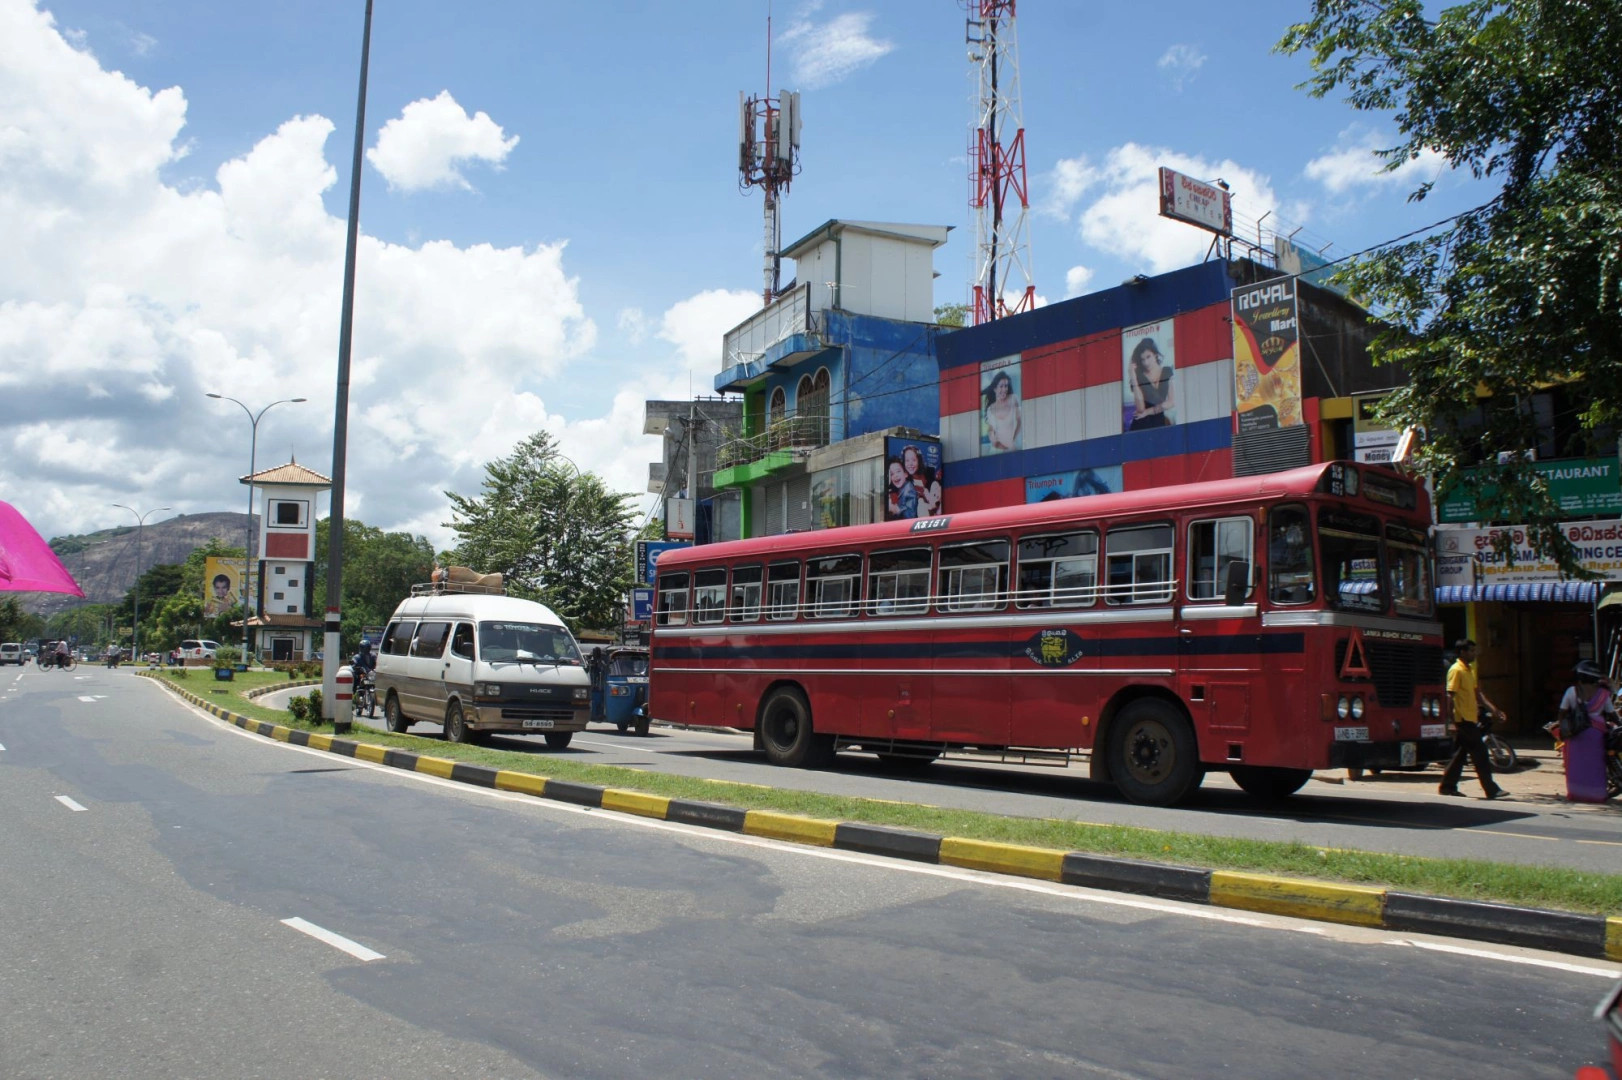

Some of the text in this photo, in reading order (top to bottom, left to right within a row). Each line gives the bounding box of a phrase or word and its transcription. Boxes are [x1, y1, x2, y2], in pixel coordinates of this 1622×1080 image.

[1238, 283, 1294, 311] ROYAL
[1271, 316, 1297, 332] Mart
[1126, 325, 1155, 337] Triumph
[1364, 452, 1391, 462] Money
[1028, 478, 1057, 489] Triumph
[1382, 631, 1400, 639] ASHOK
[1400, 633, 1423, 641] LEYLAND
